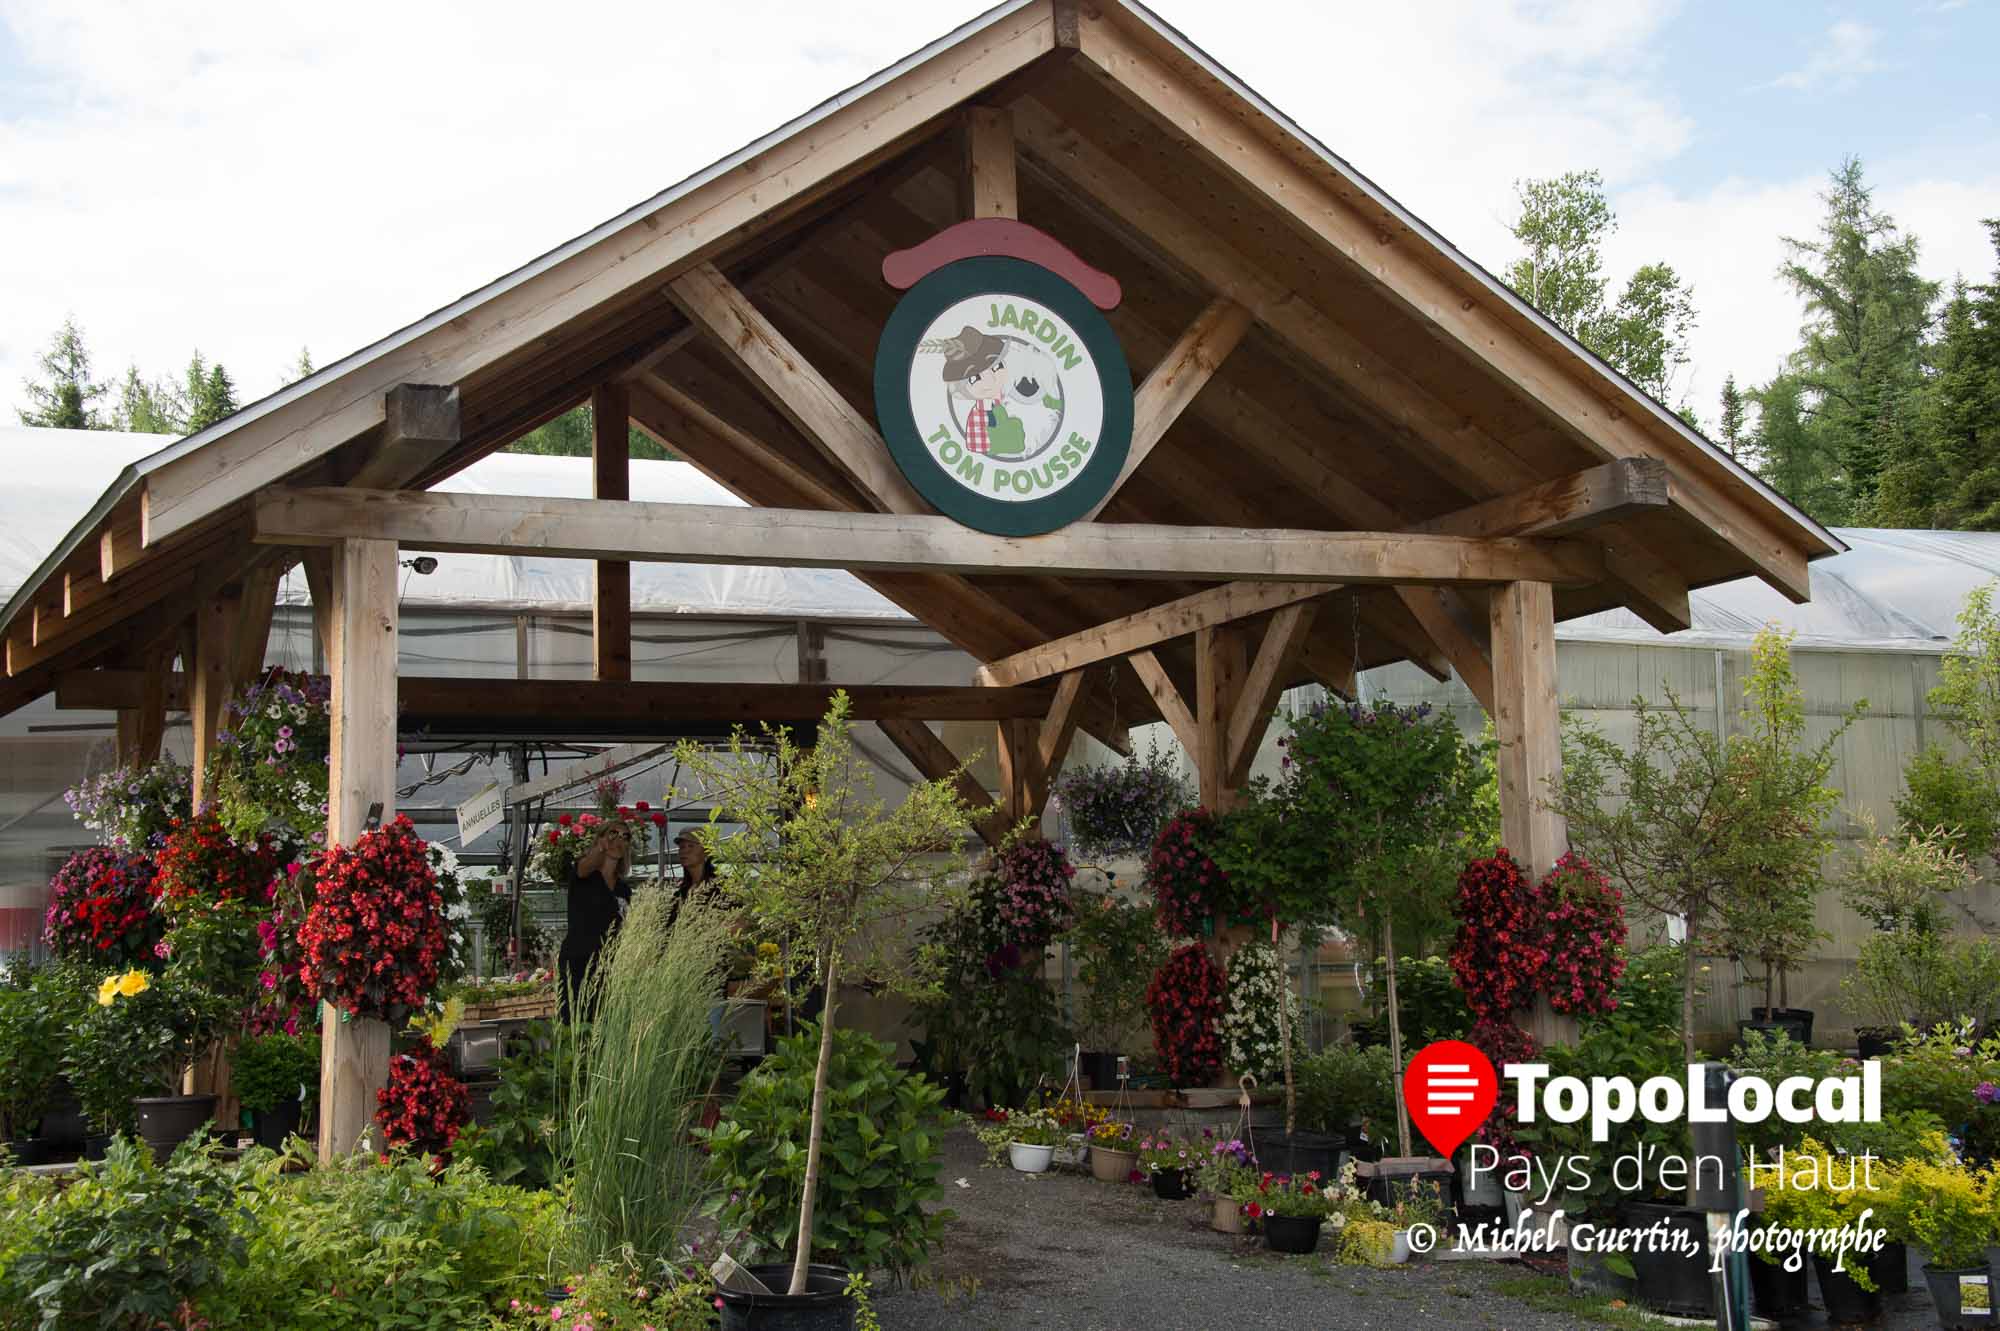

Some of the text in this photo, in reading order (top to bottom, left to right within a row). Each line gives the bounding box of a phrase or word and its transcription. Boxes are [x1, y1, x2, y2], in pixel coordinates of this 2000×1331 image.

[987, 303, 1082, 371] JARDIN
[927, 423, 1092, 494] TOM POUSSE
[462, 799, 501, 833] ANNUELLES
